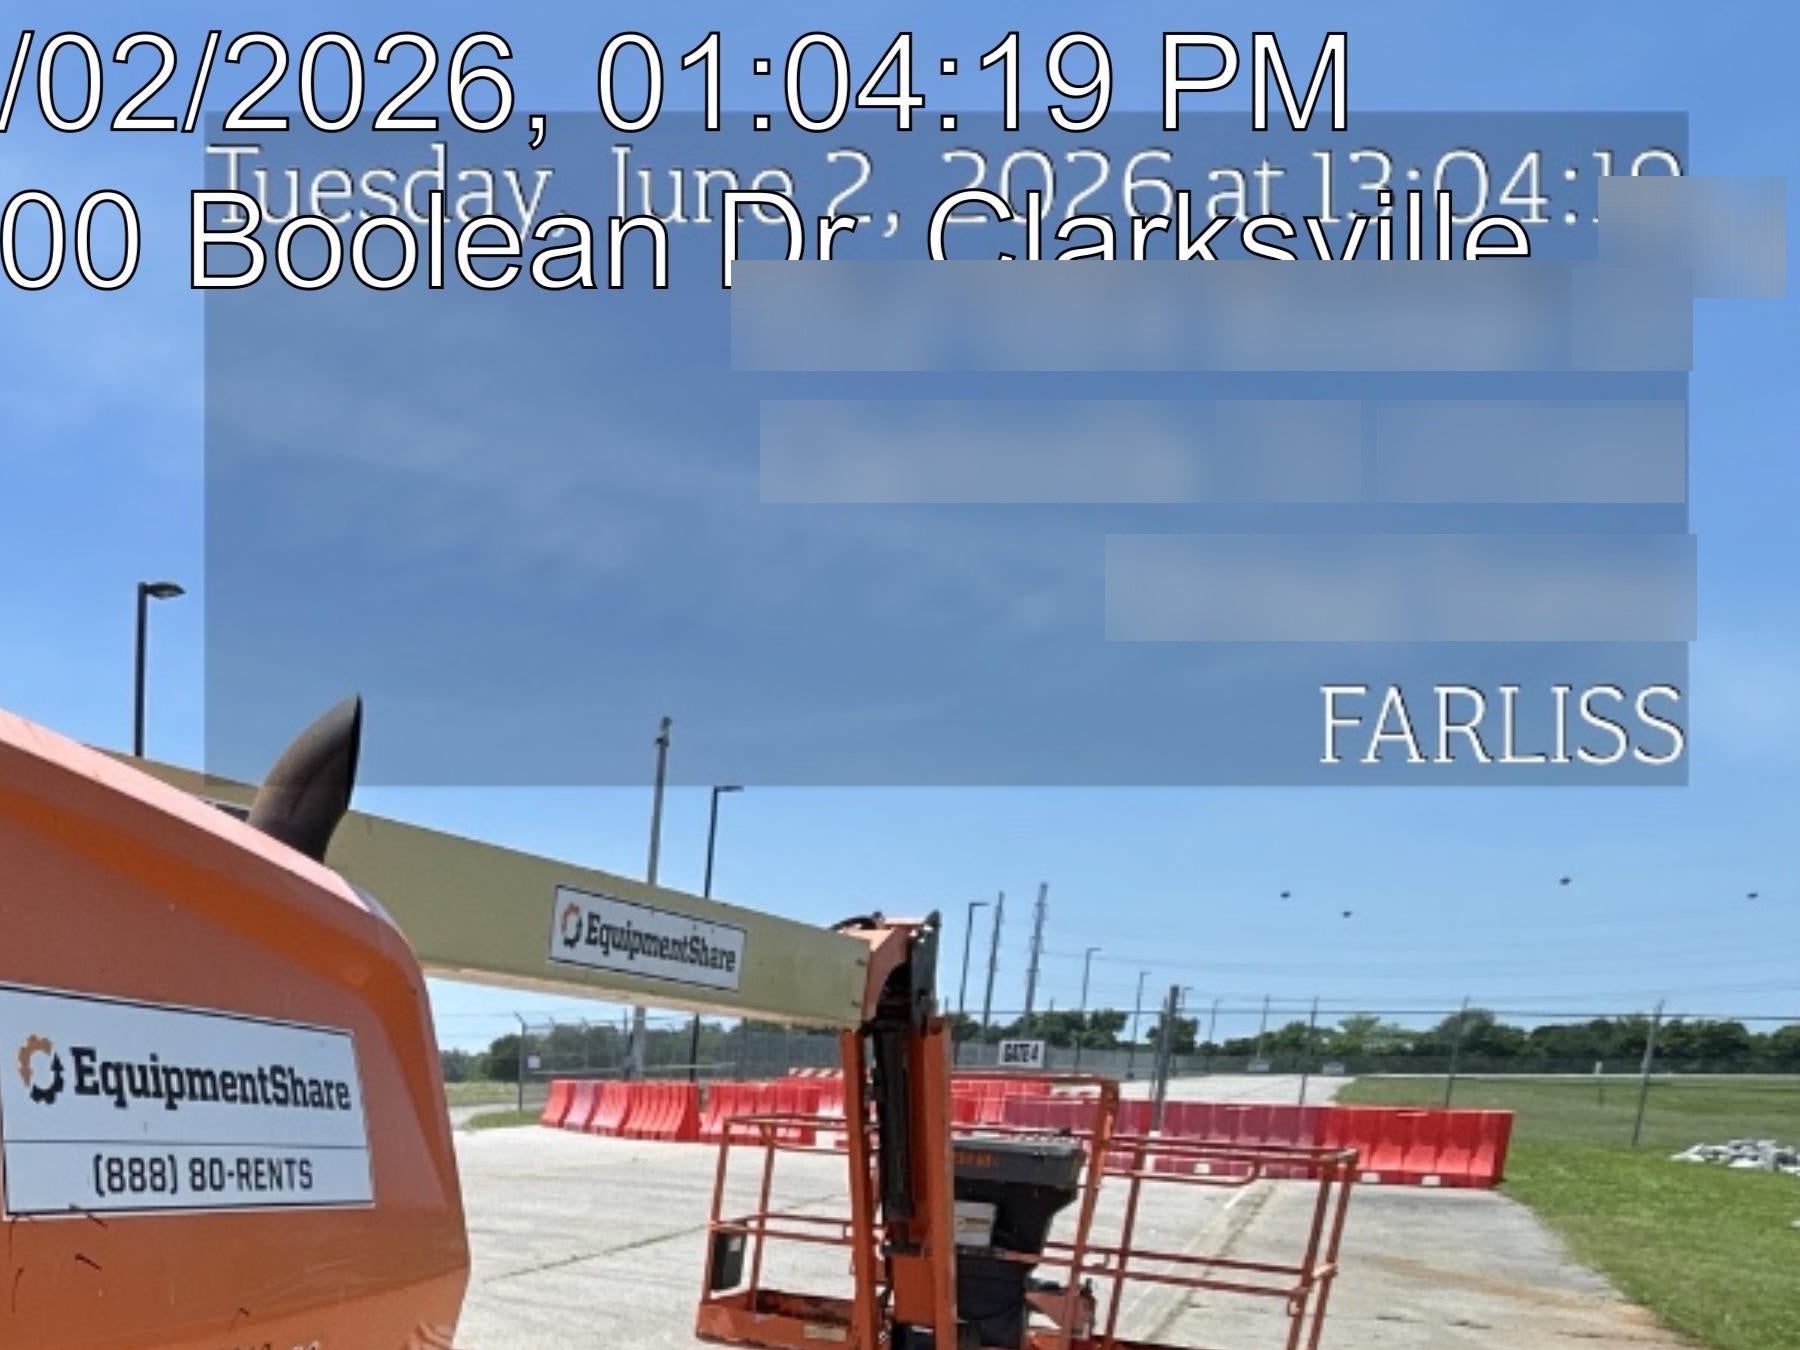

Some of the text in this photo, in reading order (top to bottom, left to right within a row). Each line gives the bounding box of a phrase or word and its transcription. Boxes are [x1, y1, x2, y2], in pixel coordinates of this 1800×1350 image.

[585, 910, 737, 973] EquipmentShare
[69, 1046, 353, 1111] EquipmentShare
[93, 1153, 314, 1197] (888) 80-RENTS
